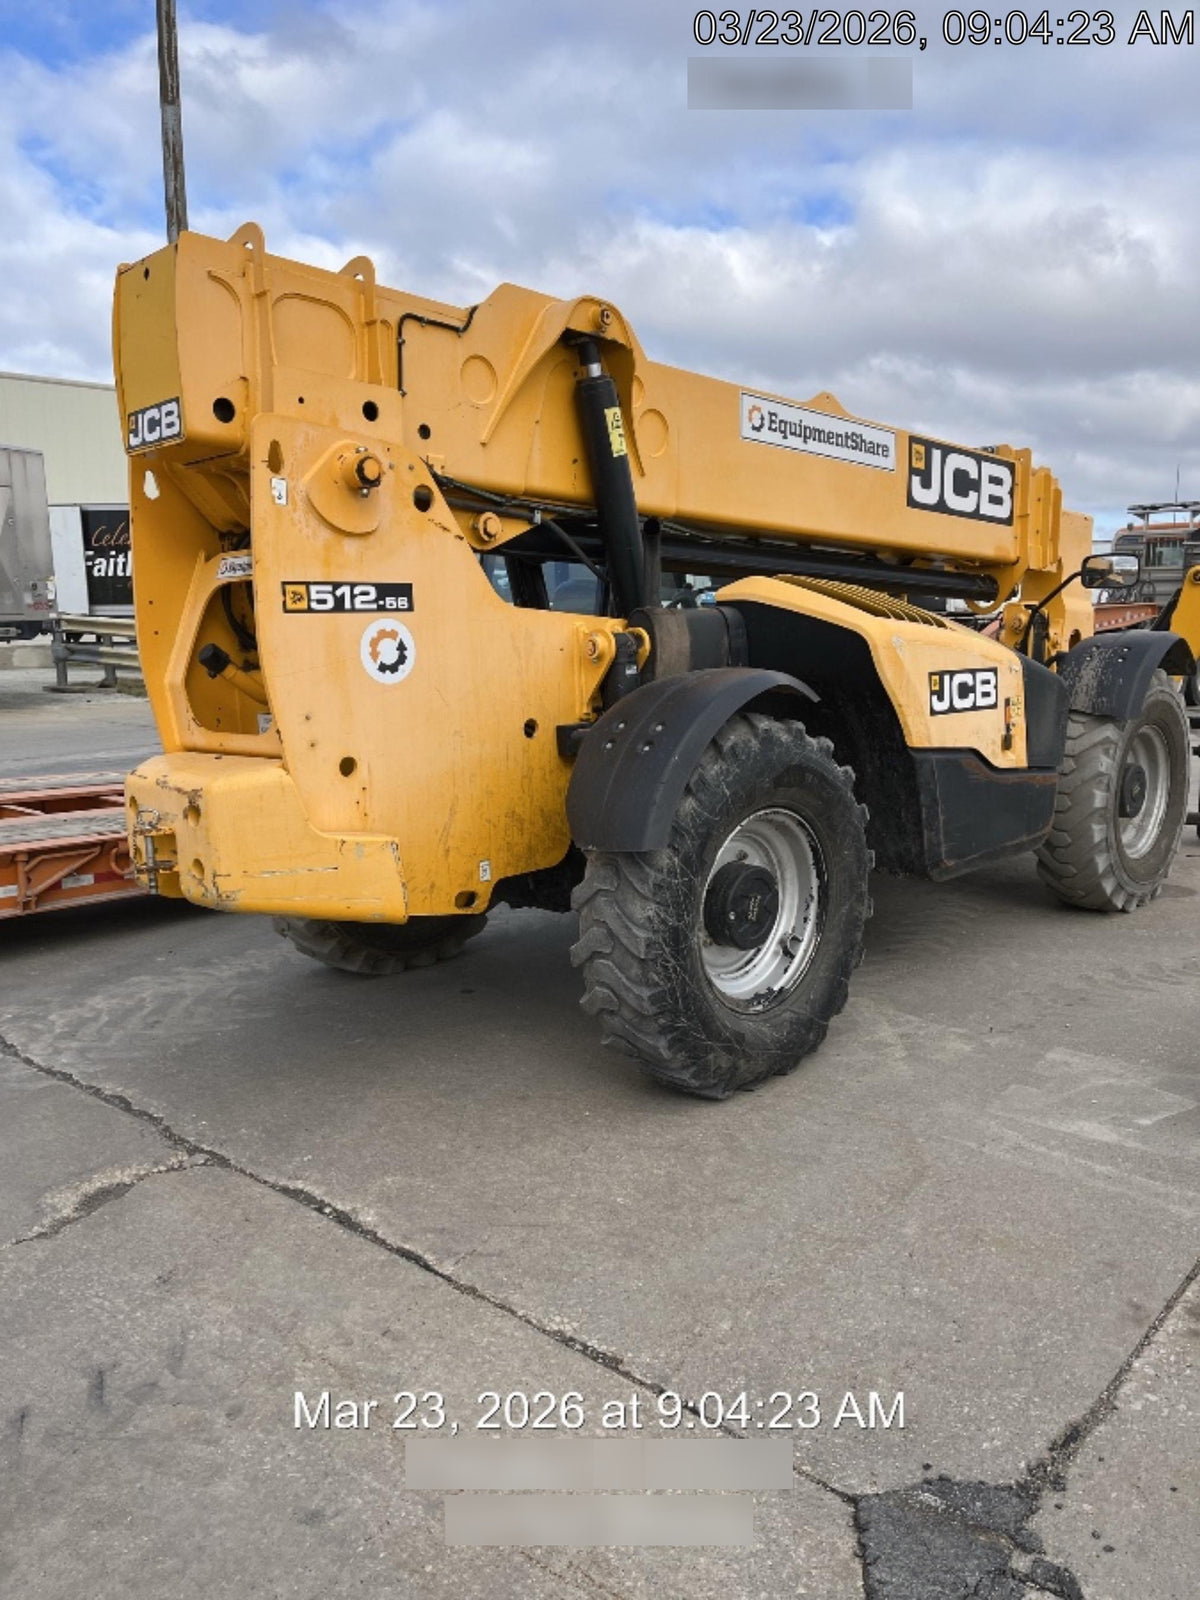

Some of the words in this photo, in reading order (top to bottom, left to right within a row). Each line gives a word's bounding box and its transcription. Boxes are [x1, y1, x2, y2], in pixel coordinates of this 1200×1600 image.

[129, 401, 180, 447] JCB
[767, 410, 890, 458] EquipmentShare
[911, 447, 1013, 519] JCB
[931, 671, 997, 712] JCB
